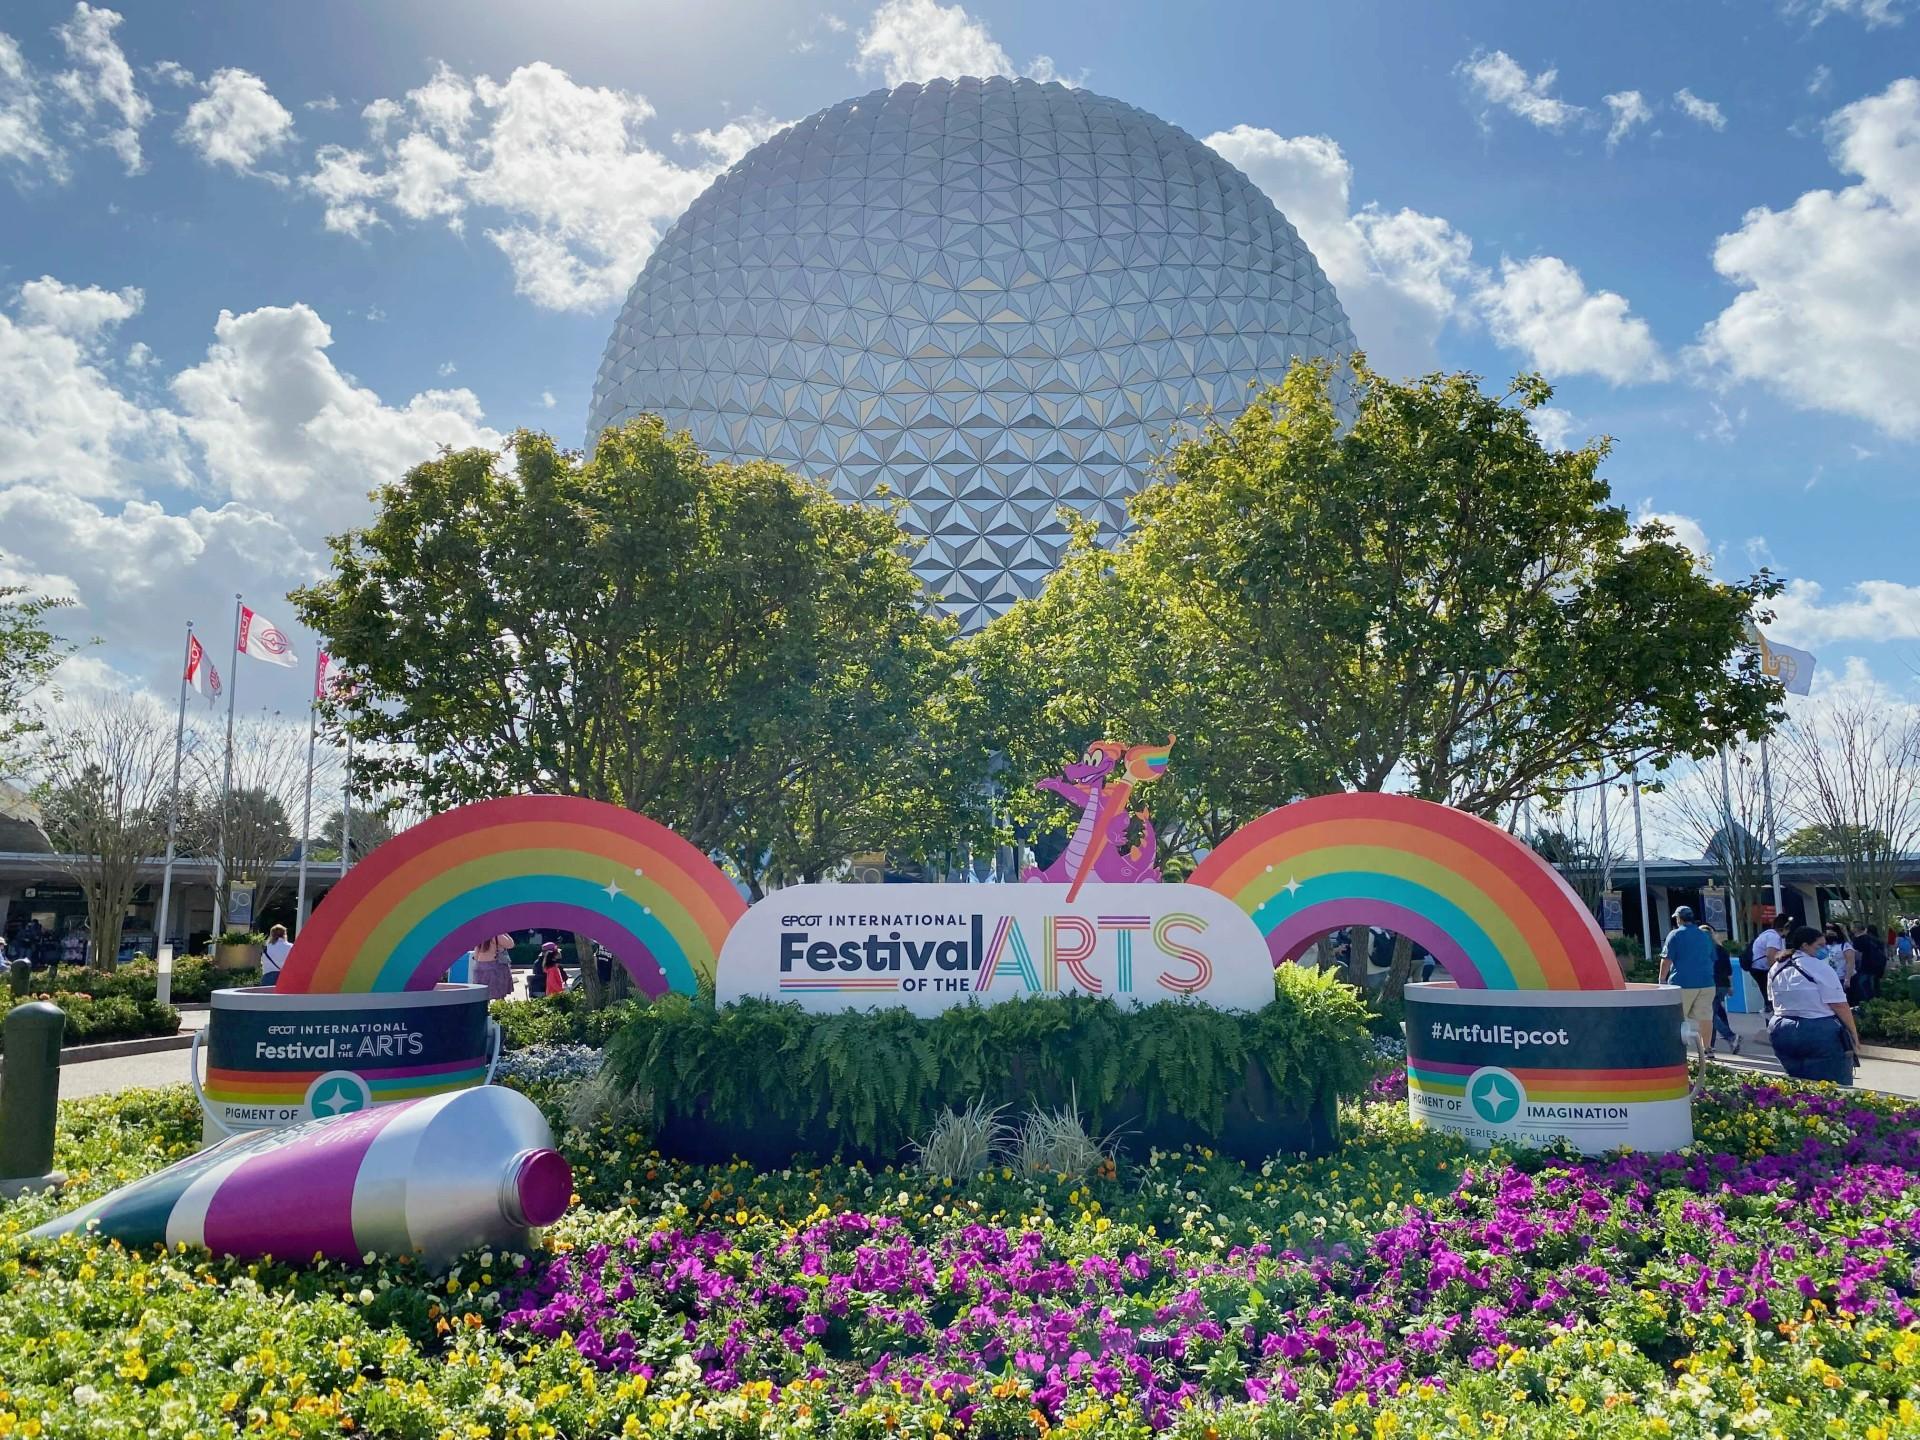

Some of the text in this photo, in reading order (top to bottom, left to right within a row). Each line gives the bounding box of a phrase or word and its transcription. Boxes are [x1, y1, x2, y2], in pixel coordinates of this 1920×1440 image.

[231, 890, 250, 913] 50
[781, 914, 967, 927] EPCOT INTERNATIONAL
[780, 914, 983, 972] Festival
[974, 912, 1213, 994] ARTS
[902, 978, 970, 992] OF THE
[268, 1022, 408, 1035] EPCOT INTERNATIONAL
[1431, 1022, 1569, 1050] #ArtfulEpcot
[255, 1038, 335, 1059] Festival
[356, 1032, 424, 1058] ARTS
[1413, 1092, 1462, 1111] PIGMENT OF
[225, 1107, 299, 1121] PIGMENT OF
[1527, 1106, 1629, 1119] IMAGINATION
[1464, 1127, 1498, 1139] SERIES
